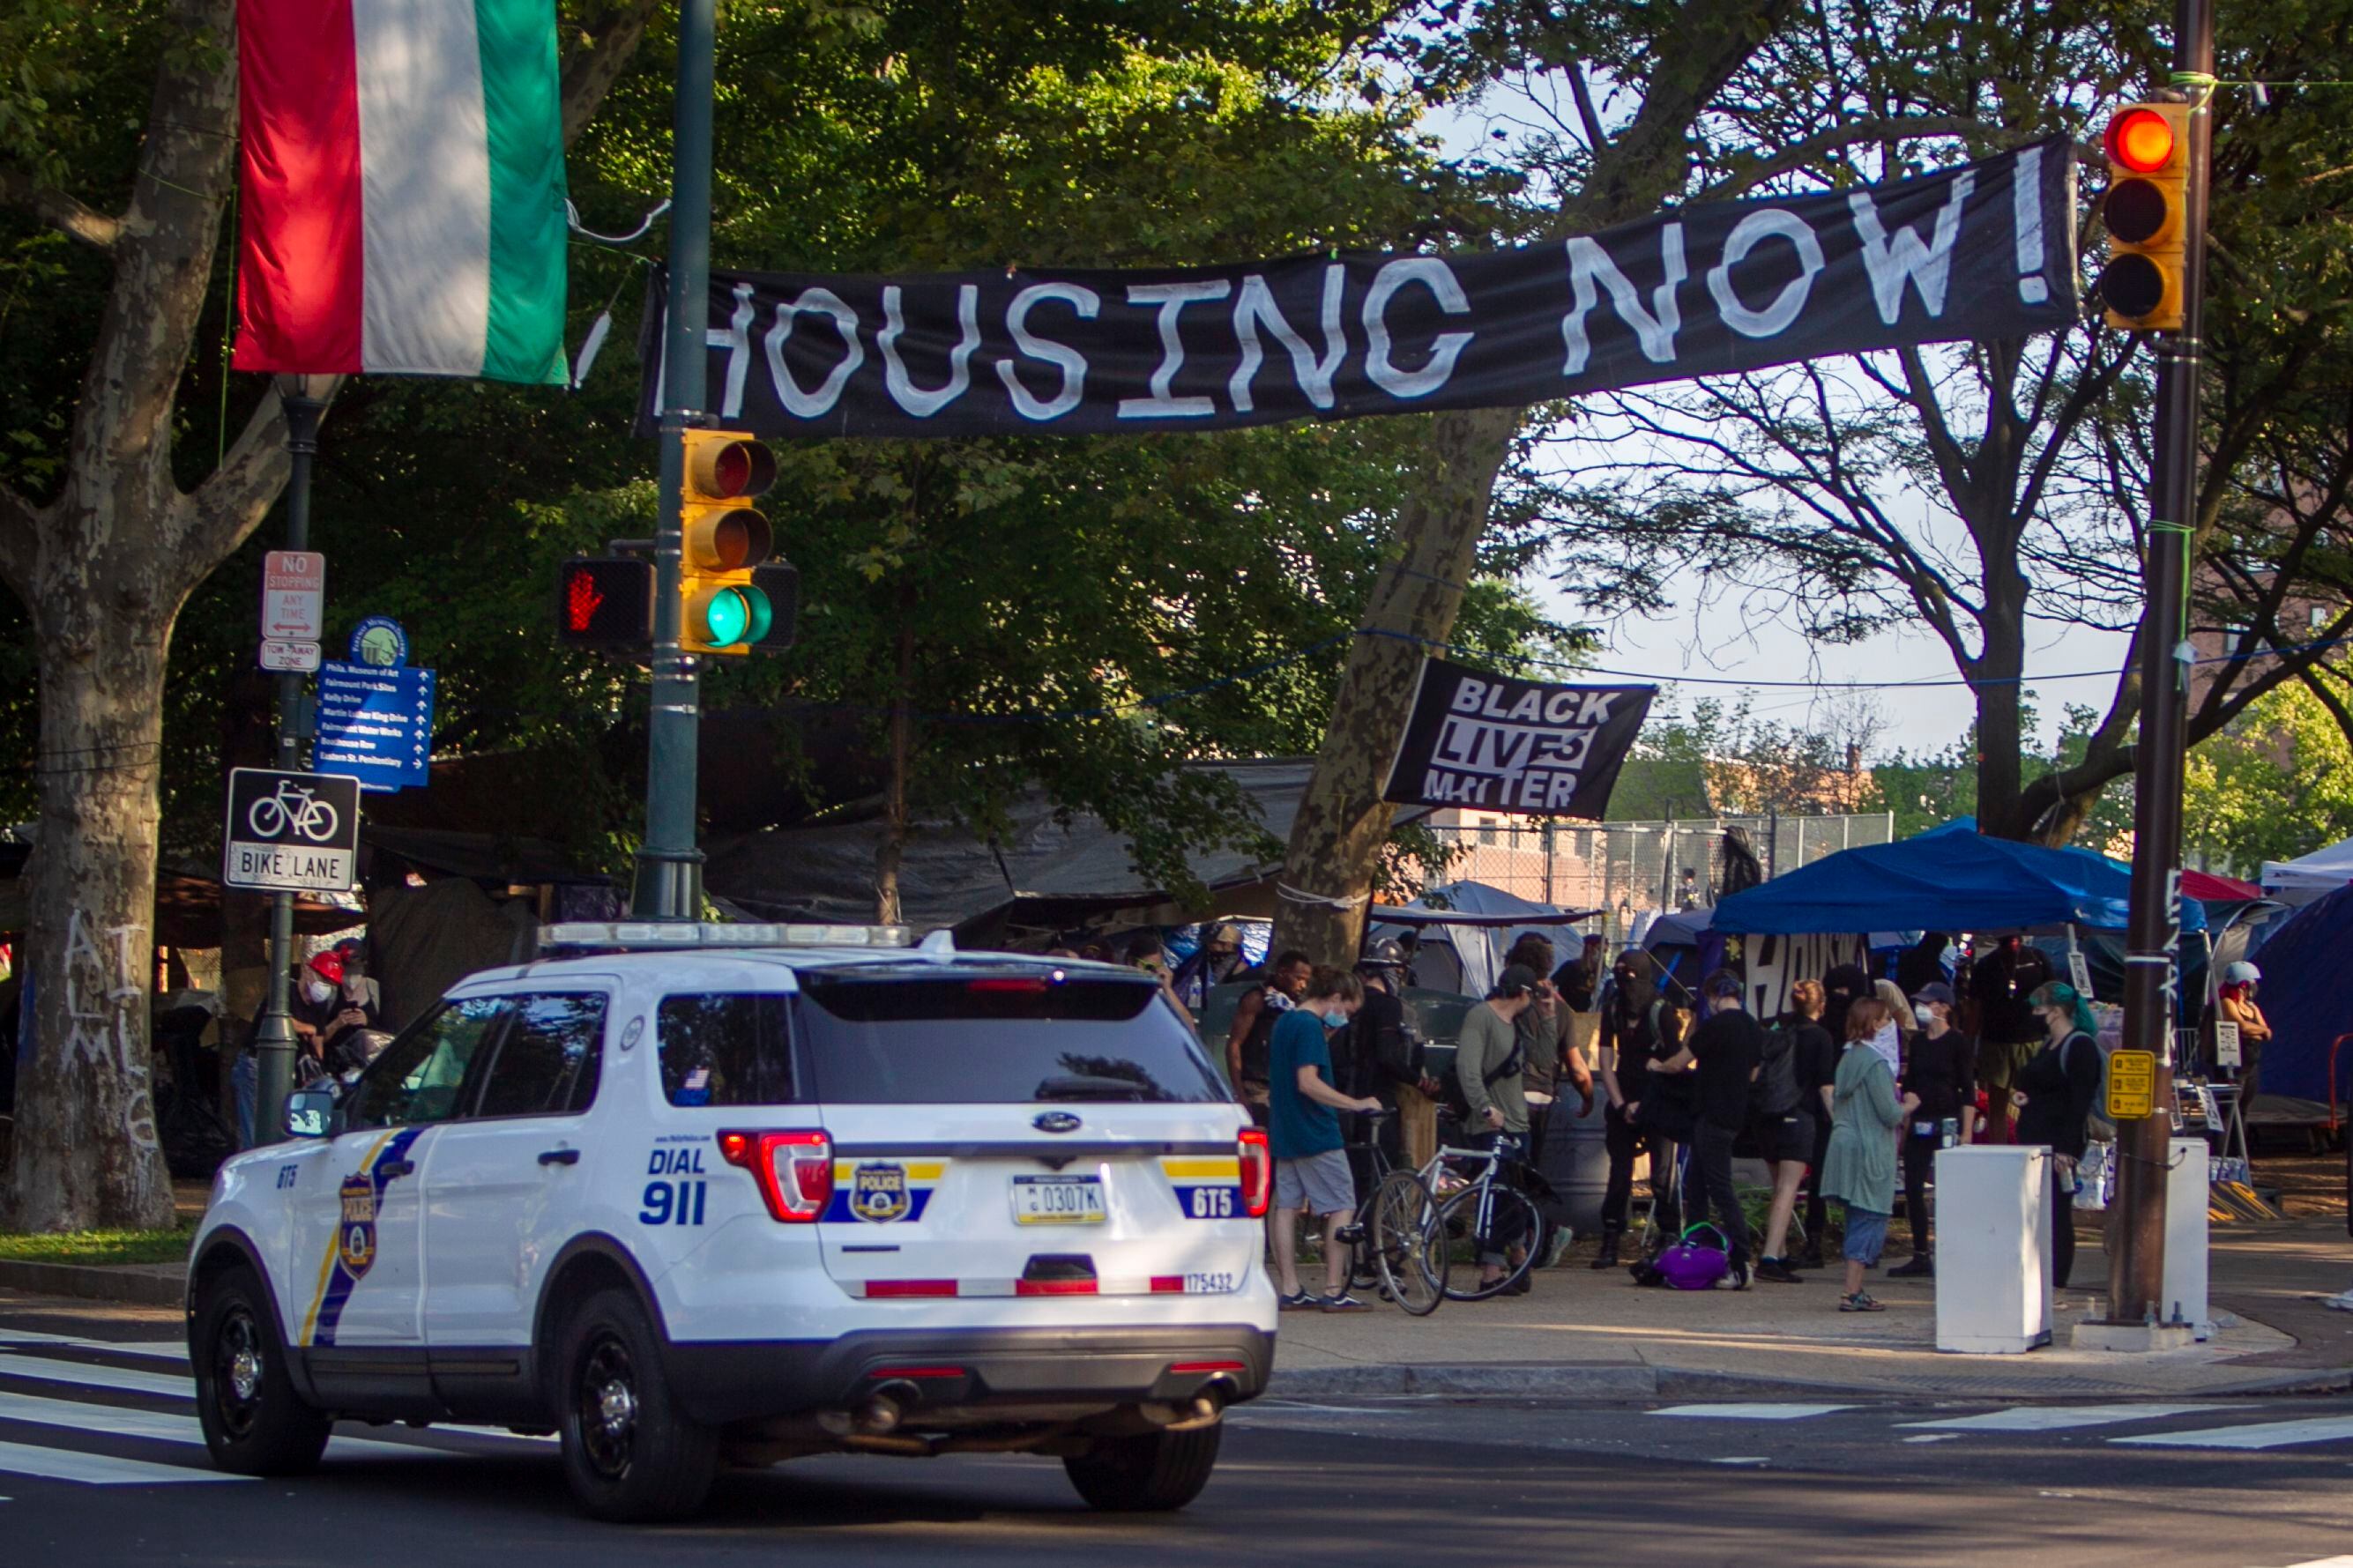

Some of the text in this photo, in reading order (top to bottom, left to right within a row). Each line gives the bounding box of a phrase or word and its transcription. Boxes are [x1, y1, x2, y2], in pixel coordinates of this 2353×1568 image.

[654, 146, 2049, 421] HOUSING NOW!
[282, 555, 307, 573] NO
[269, 576, 319, 589] STOPPING
[282, 594, 304, 606] ANY
[280, 607, 306, 620] TIME
[279, 656, 303, 666] ZONE
[347, 665, 378, 675] Museum
[324, 678, 361, 688] Fairmount
[324, 693, 362, 703] Kelly Drive
[1451, 676, 1621, 725] BLACK
[323, 708, 347, 717] Martin
[371, 711, 389, 723] King
[389, 713, 408, 723] Drive
[322, 722, 358, 733] Fairmount
[319, 751, 347, 762] Eastern
[1422, 769, 1577, 808] MATTER
[241, 851, 339, 880] BIKE LANE
[648, 1148, 705, 1175] DIAL
[276, 1164, 298, 1190] 6T5
[860, 1175, 900, 1191] POLICE
[639, 1181, 706, 1225] 911
[1044, 1186, 1098, 1211] 0307K
[1193, 1187, 1232, 1217] 6T5
[1188, 1273, 1234, 1293] 175432
